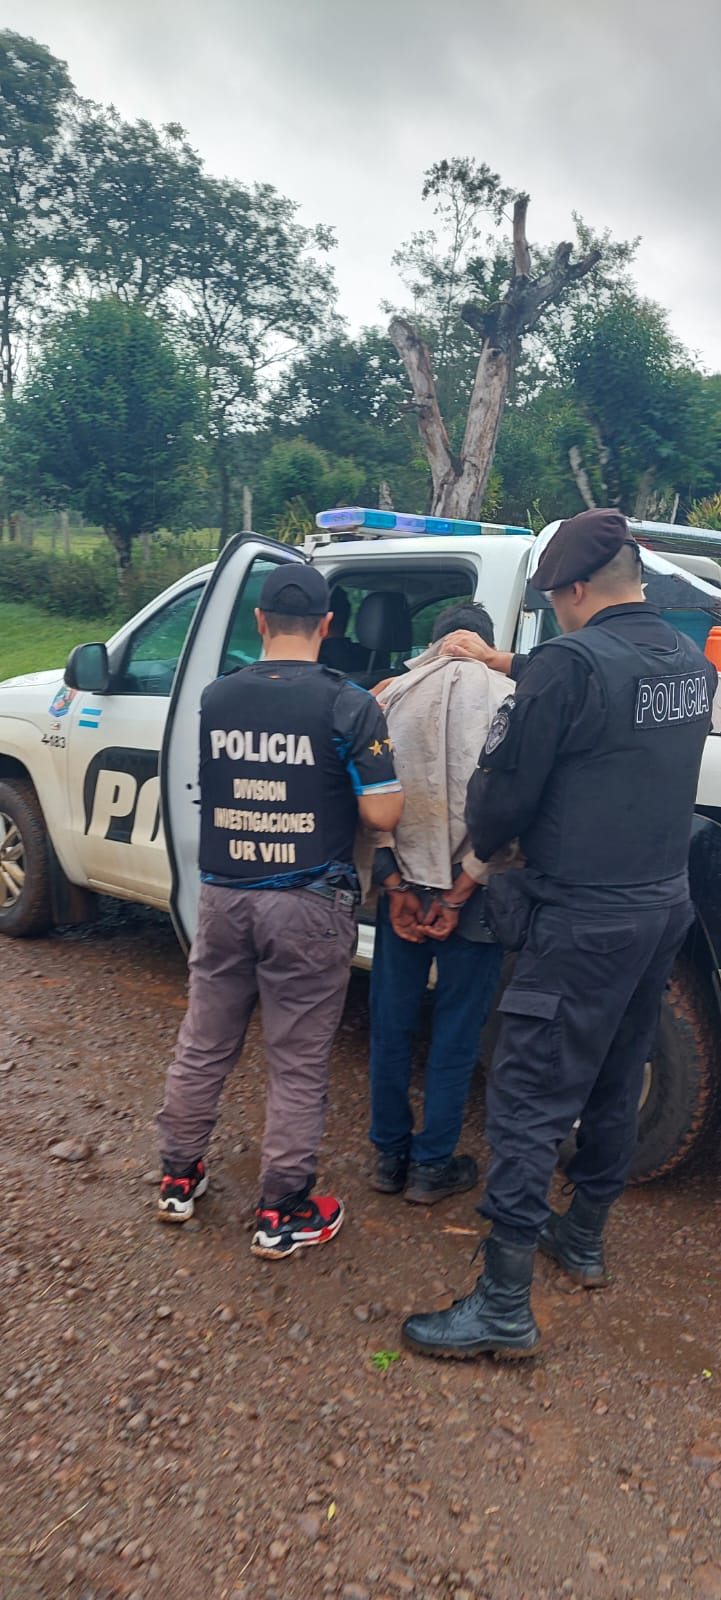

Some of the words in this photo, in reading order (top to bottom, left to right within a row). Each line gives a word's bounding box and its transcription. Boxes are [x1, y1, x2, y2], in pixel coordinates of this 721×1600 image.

[636, 676, 710, 724] POLICIA
[210, 729, 315, 766] POLICIA
[233, 778, 287, 802] DIVISION
[214, 807, 315, 834] INVESTIGACIONES
[229, 839, 257, 862] UR
[258, 842, 296, 864] VIII
